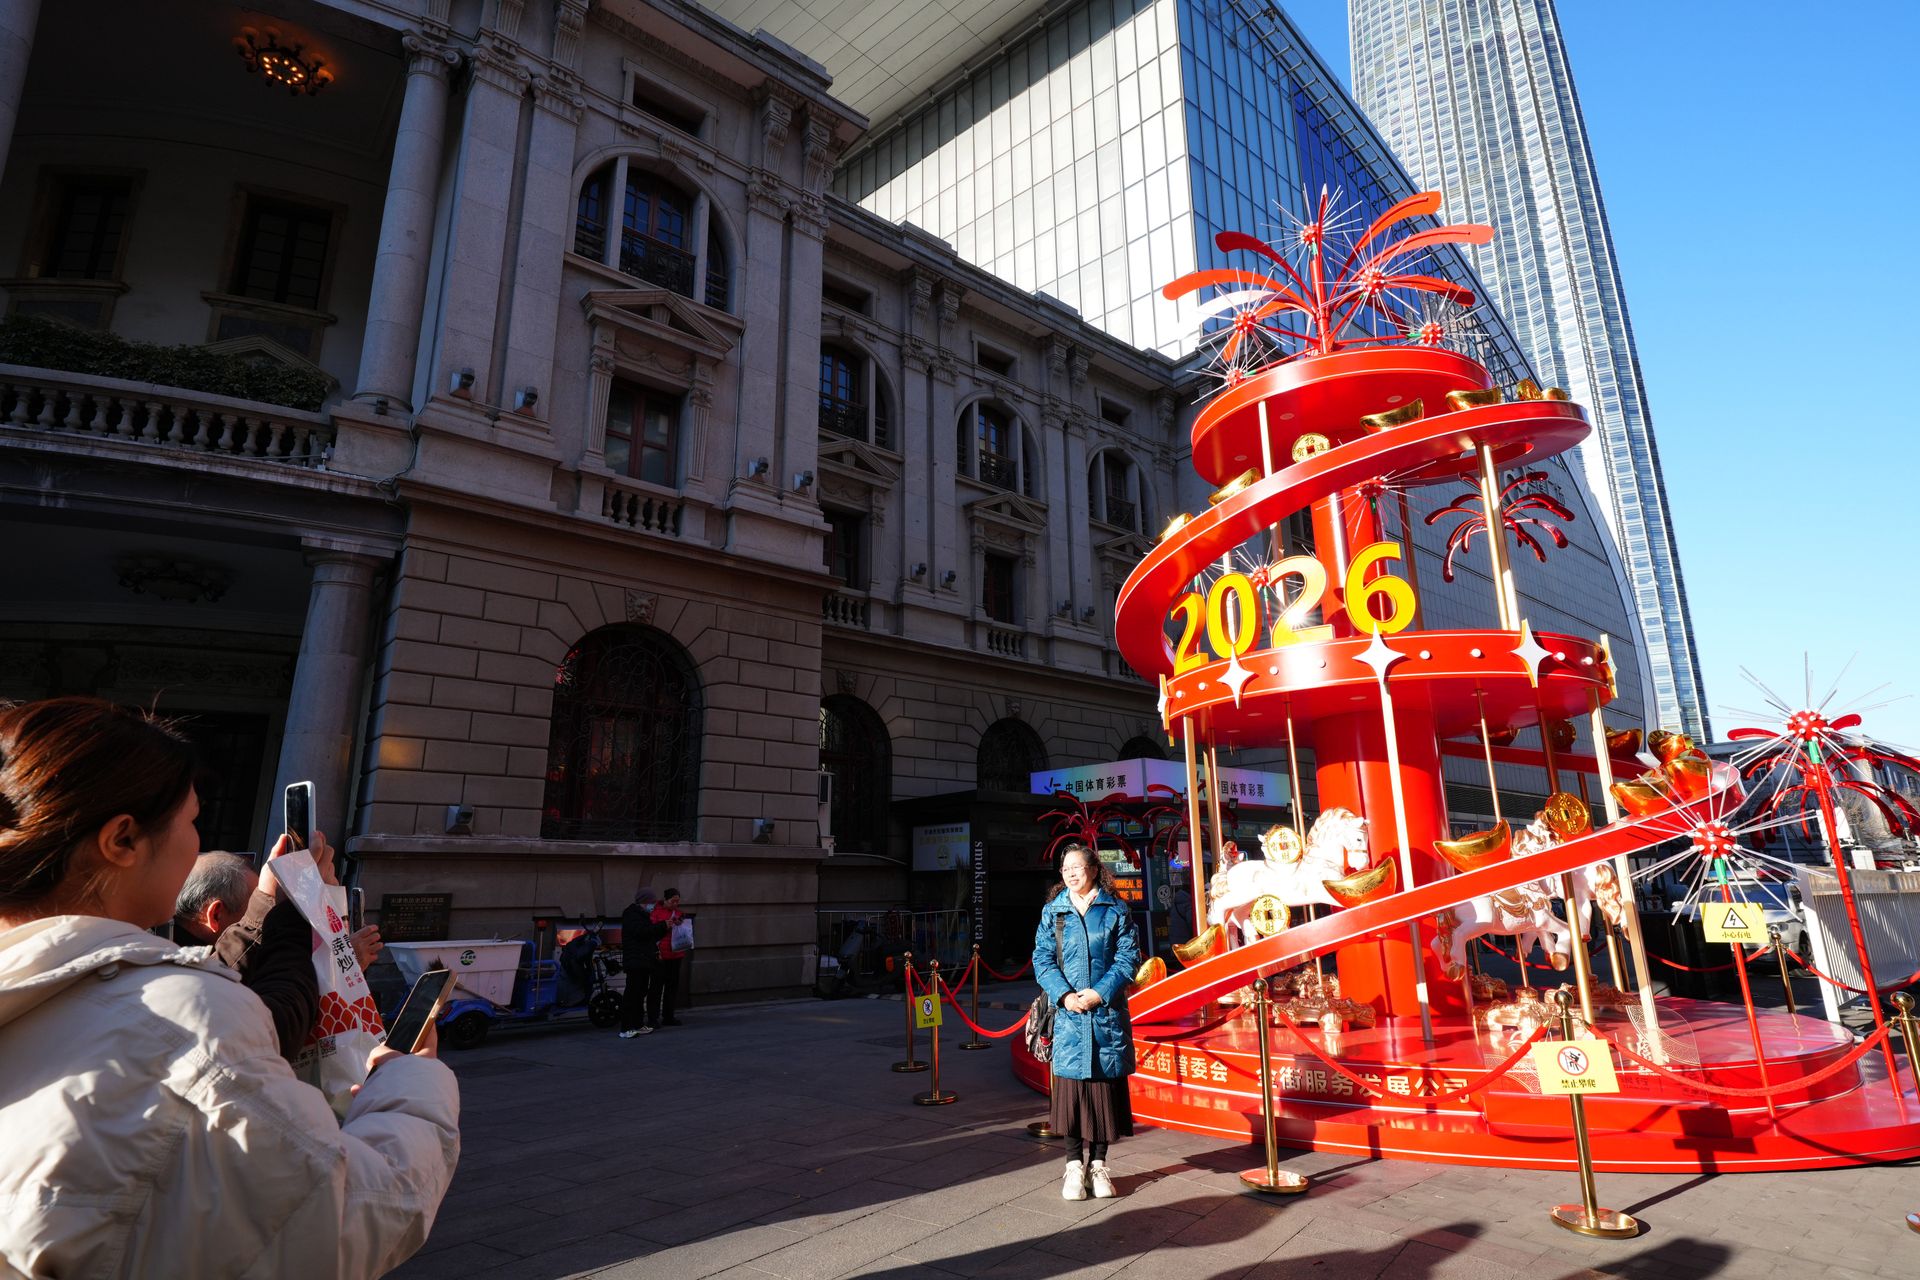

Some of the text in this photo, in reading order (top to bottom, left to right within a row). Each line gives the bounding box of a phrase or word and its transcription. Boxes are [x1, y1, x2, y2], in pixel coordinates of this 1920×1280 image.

[1170, 541, 1416, 676] 2026
[1065, 774, 1127, 793] 中国体育彩票
[1220, 780, 1265, 798] 国体育彩票
[972, 841, 986, 940] smoking area
